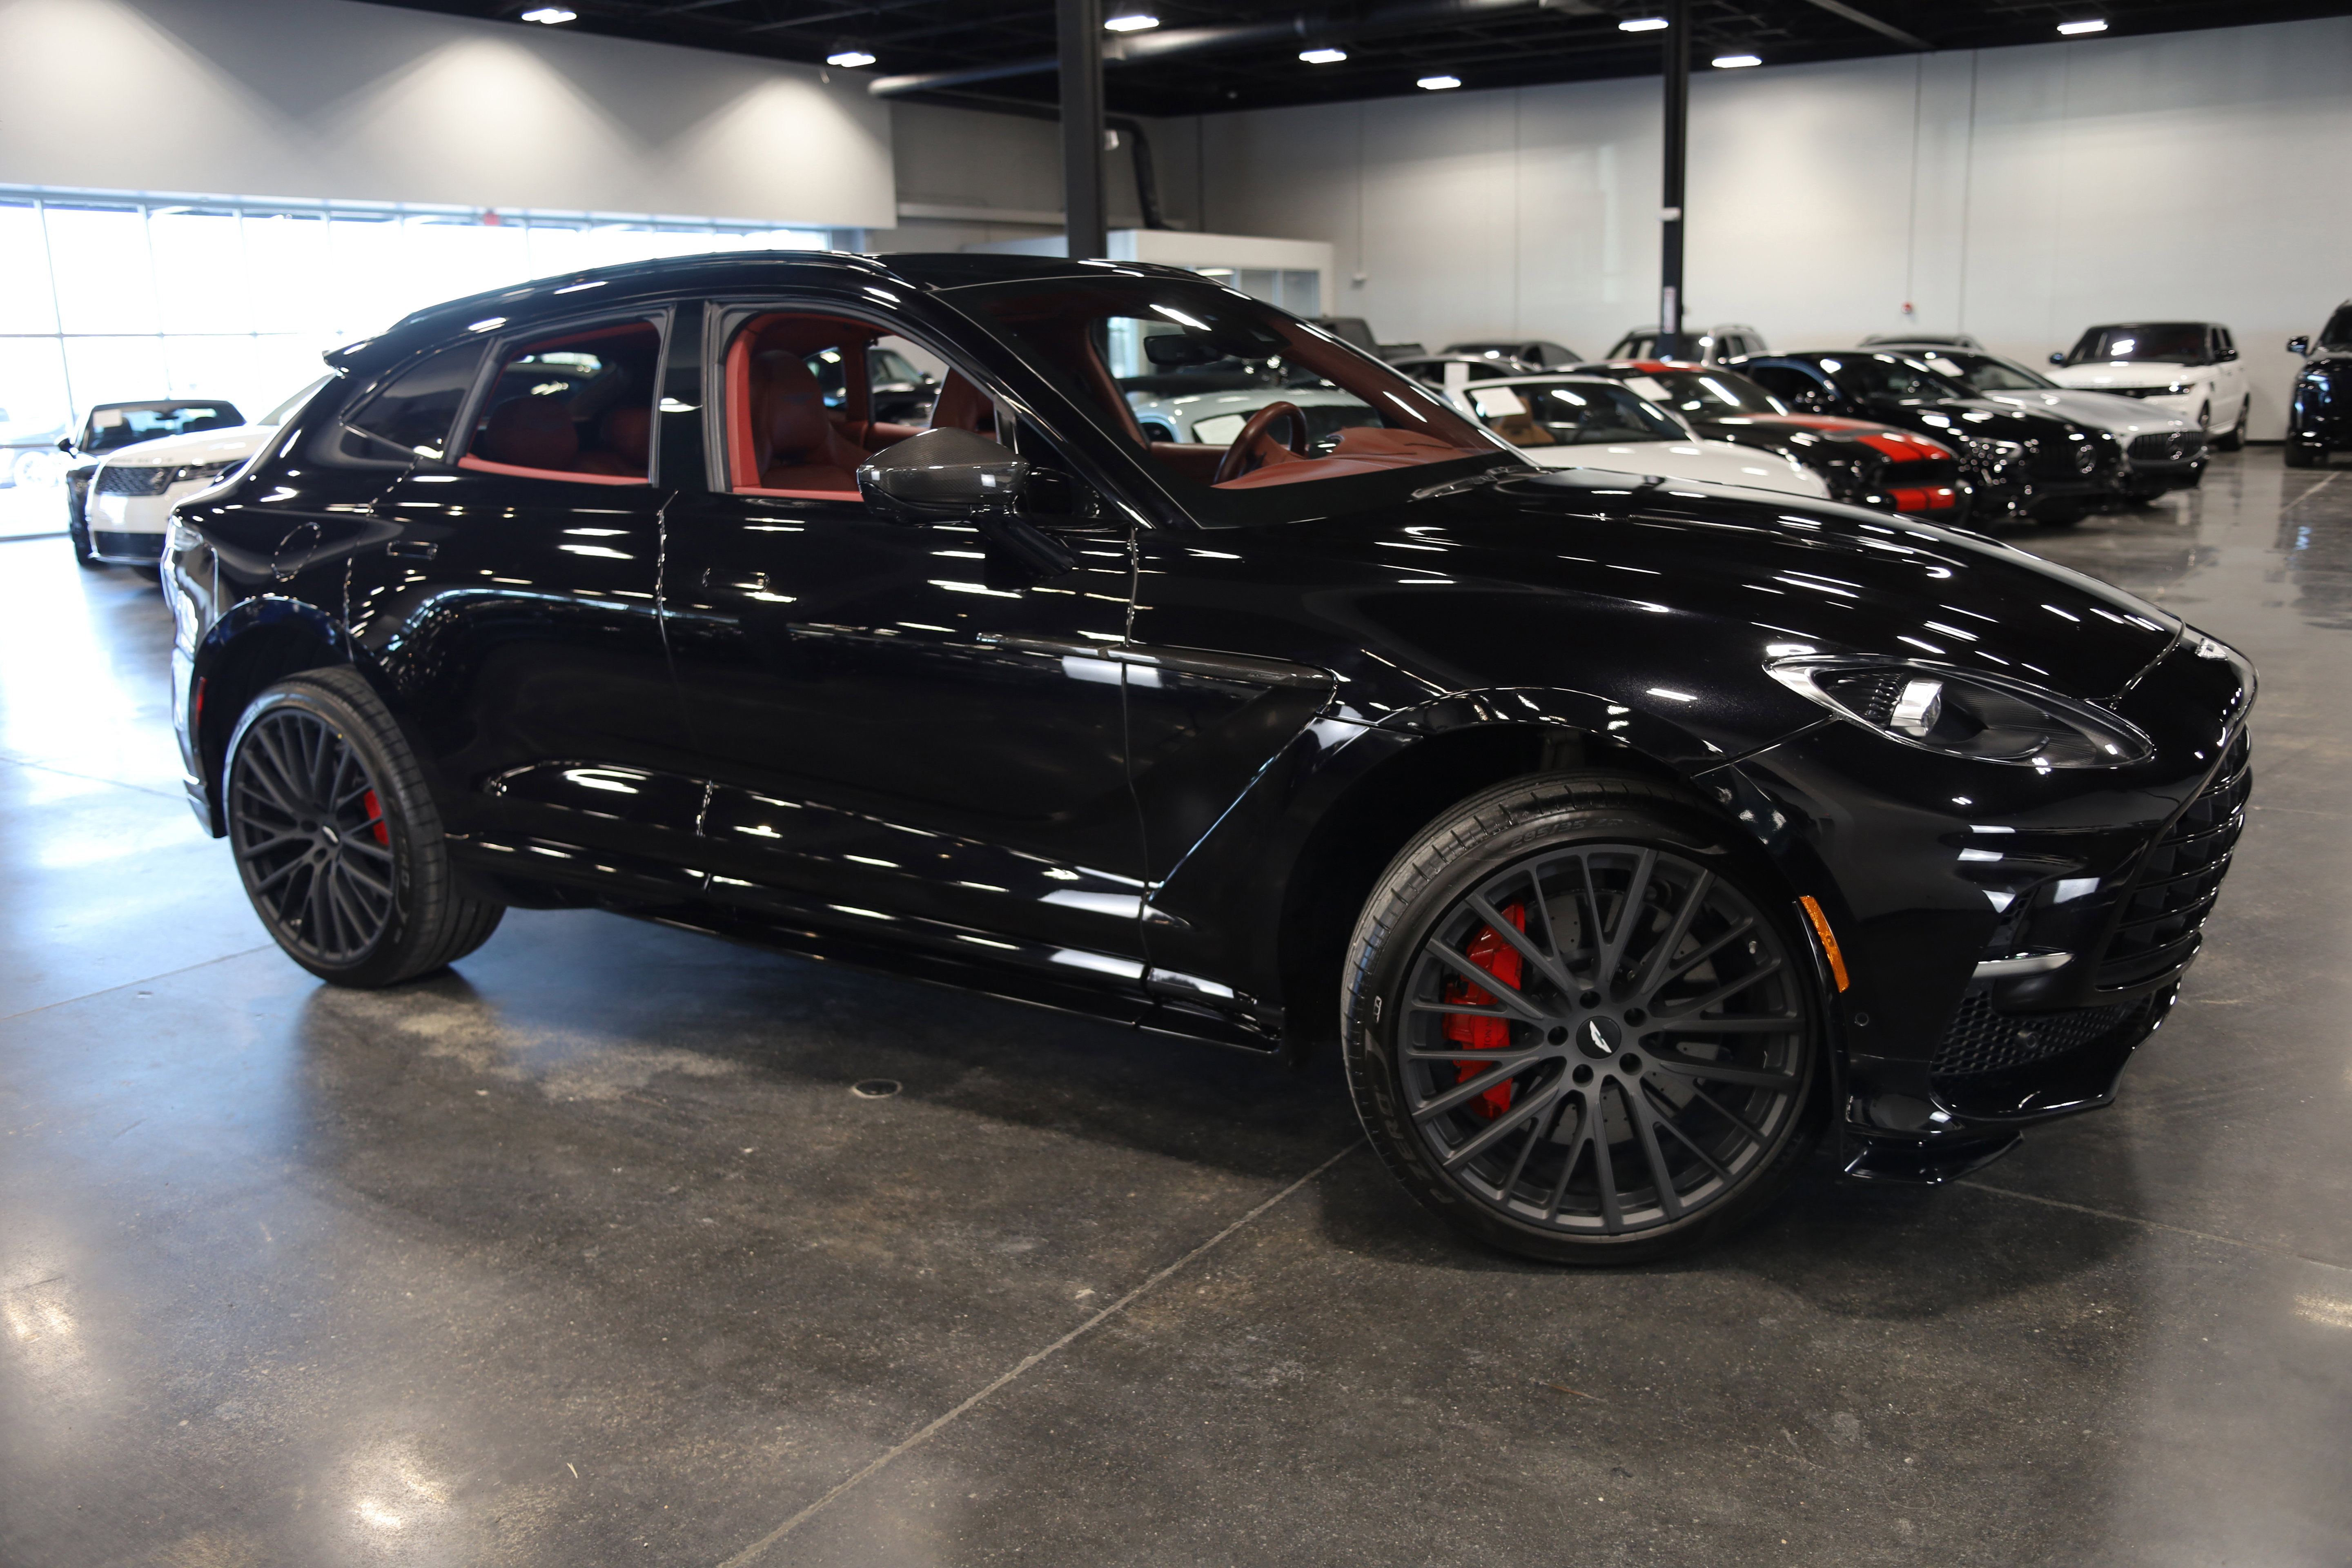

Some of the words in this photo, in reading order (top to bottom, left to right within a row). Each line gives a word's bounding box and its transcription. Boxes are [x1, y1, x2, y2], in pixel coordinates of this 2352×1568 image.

[1511, 819, 1587, 848] 285/35
[1375, 1091, 1433, 1181] ZERO
[1429, 1188, 1456, 1203] P
